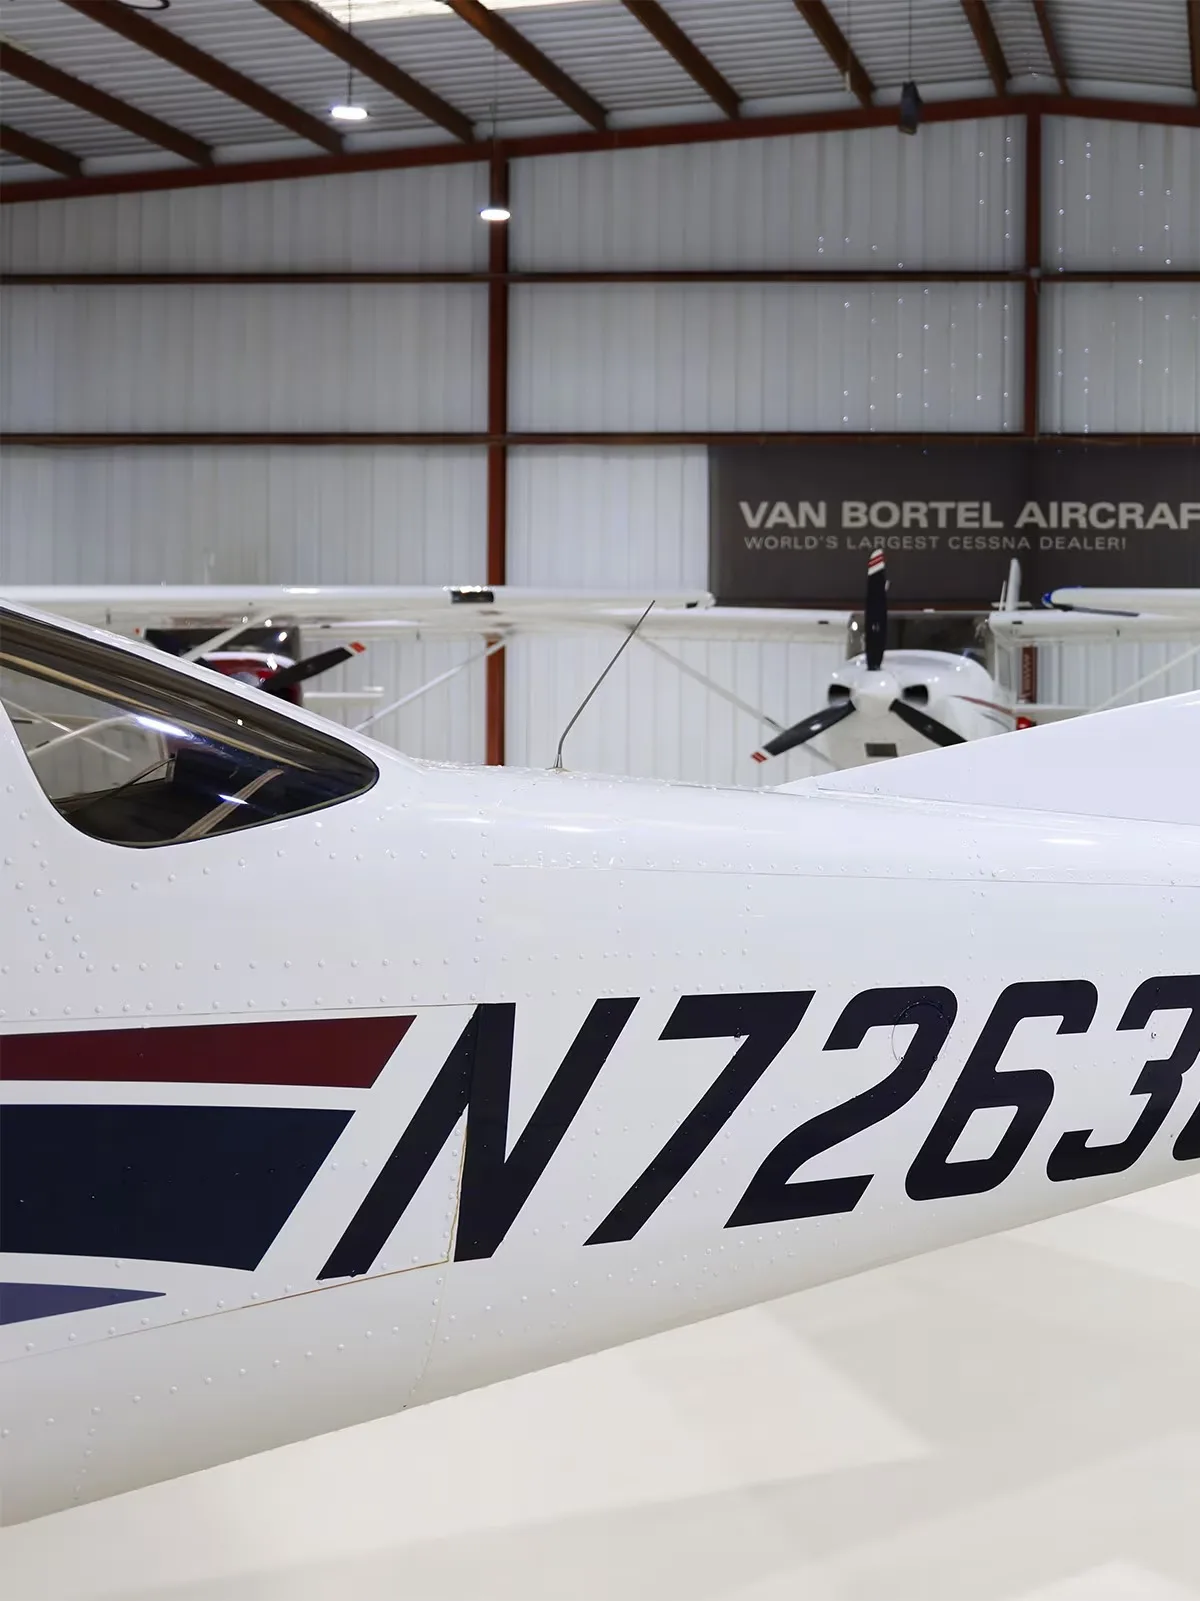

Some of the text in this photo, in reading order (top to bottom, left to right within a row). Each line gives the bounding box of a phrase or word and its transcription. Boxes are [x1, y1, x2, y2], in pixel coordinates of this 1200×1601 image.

[739, 500, 827, 530] VAN
[841, 500, 1004, 530] BORTEL
[744, 535, 1126, 550] WORLD'S LARGEST CESSNA DEALER!
